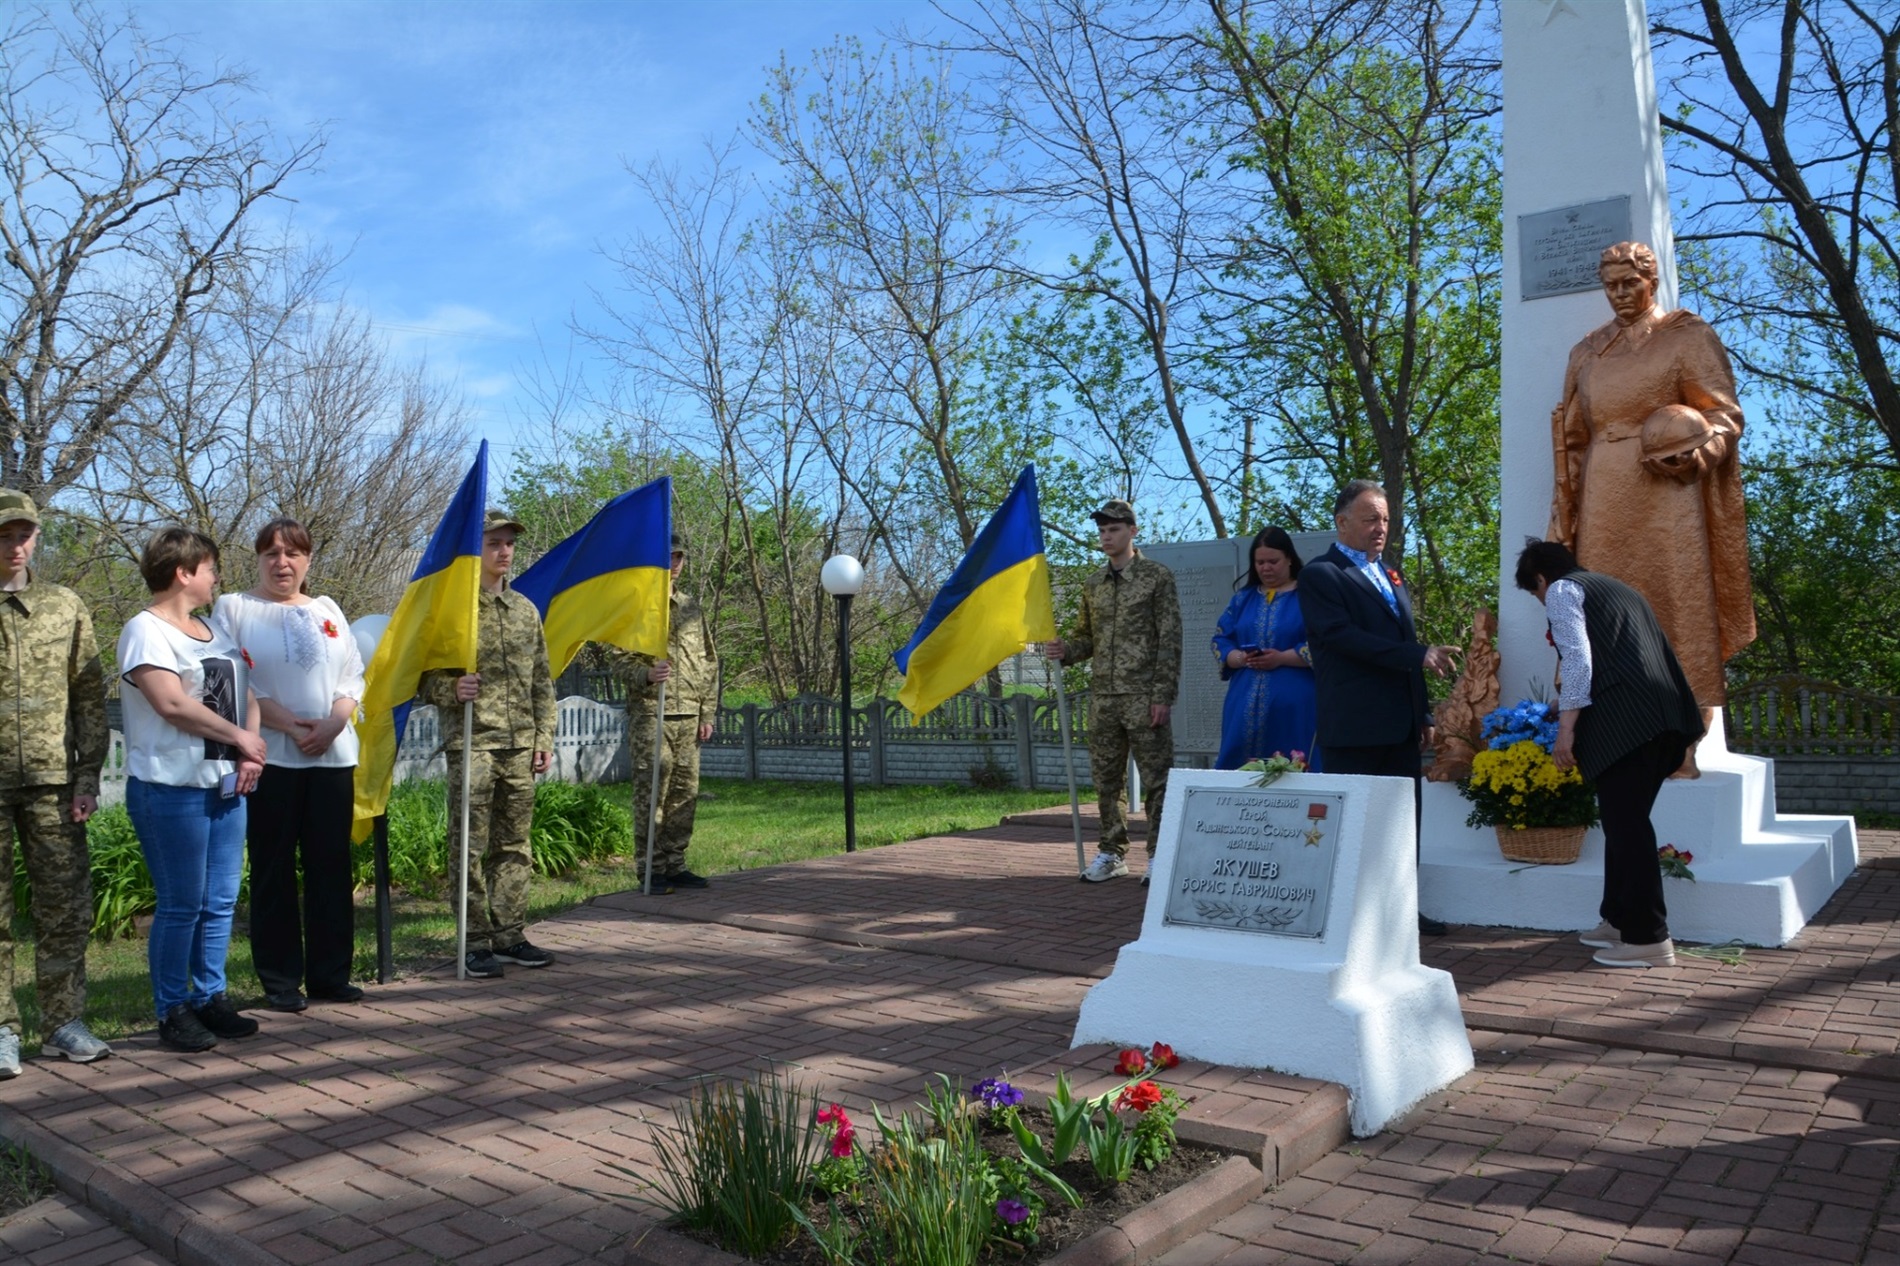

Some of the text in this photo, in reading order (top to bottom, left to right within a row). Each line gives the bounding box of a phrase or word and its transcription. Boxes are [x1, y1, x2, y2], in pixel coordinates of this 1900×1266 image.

[1216, 796, 1299, 809] ТУТ ЗАХОРОНЕНИЙ
[1226, 838, 1274, 851] ЛЕЙТЕНАНТ
[1212, 857, 1279, 879] ЯКУШЕВ
[1182, 877, 1316, 902] БОРИС ГАВРИЛОВИЧ
